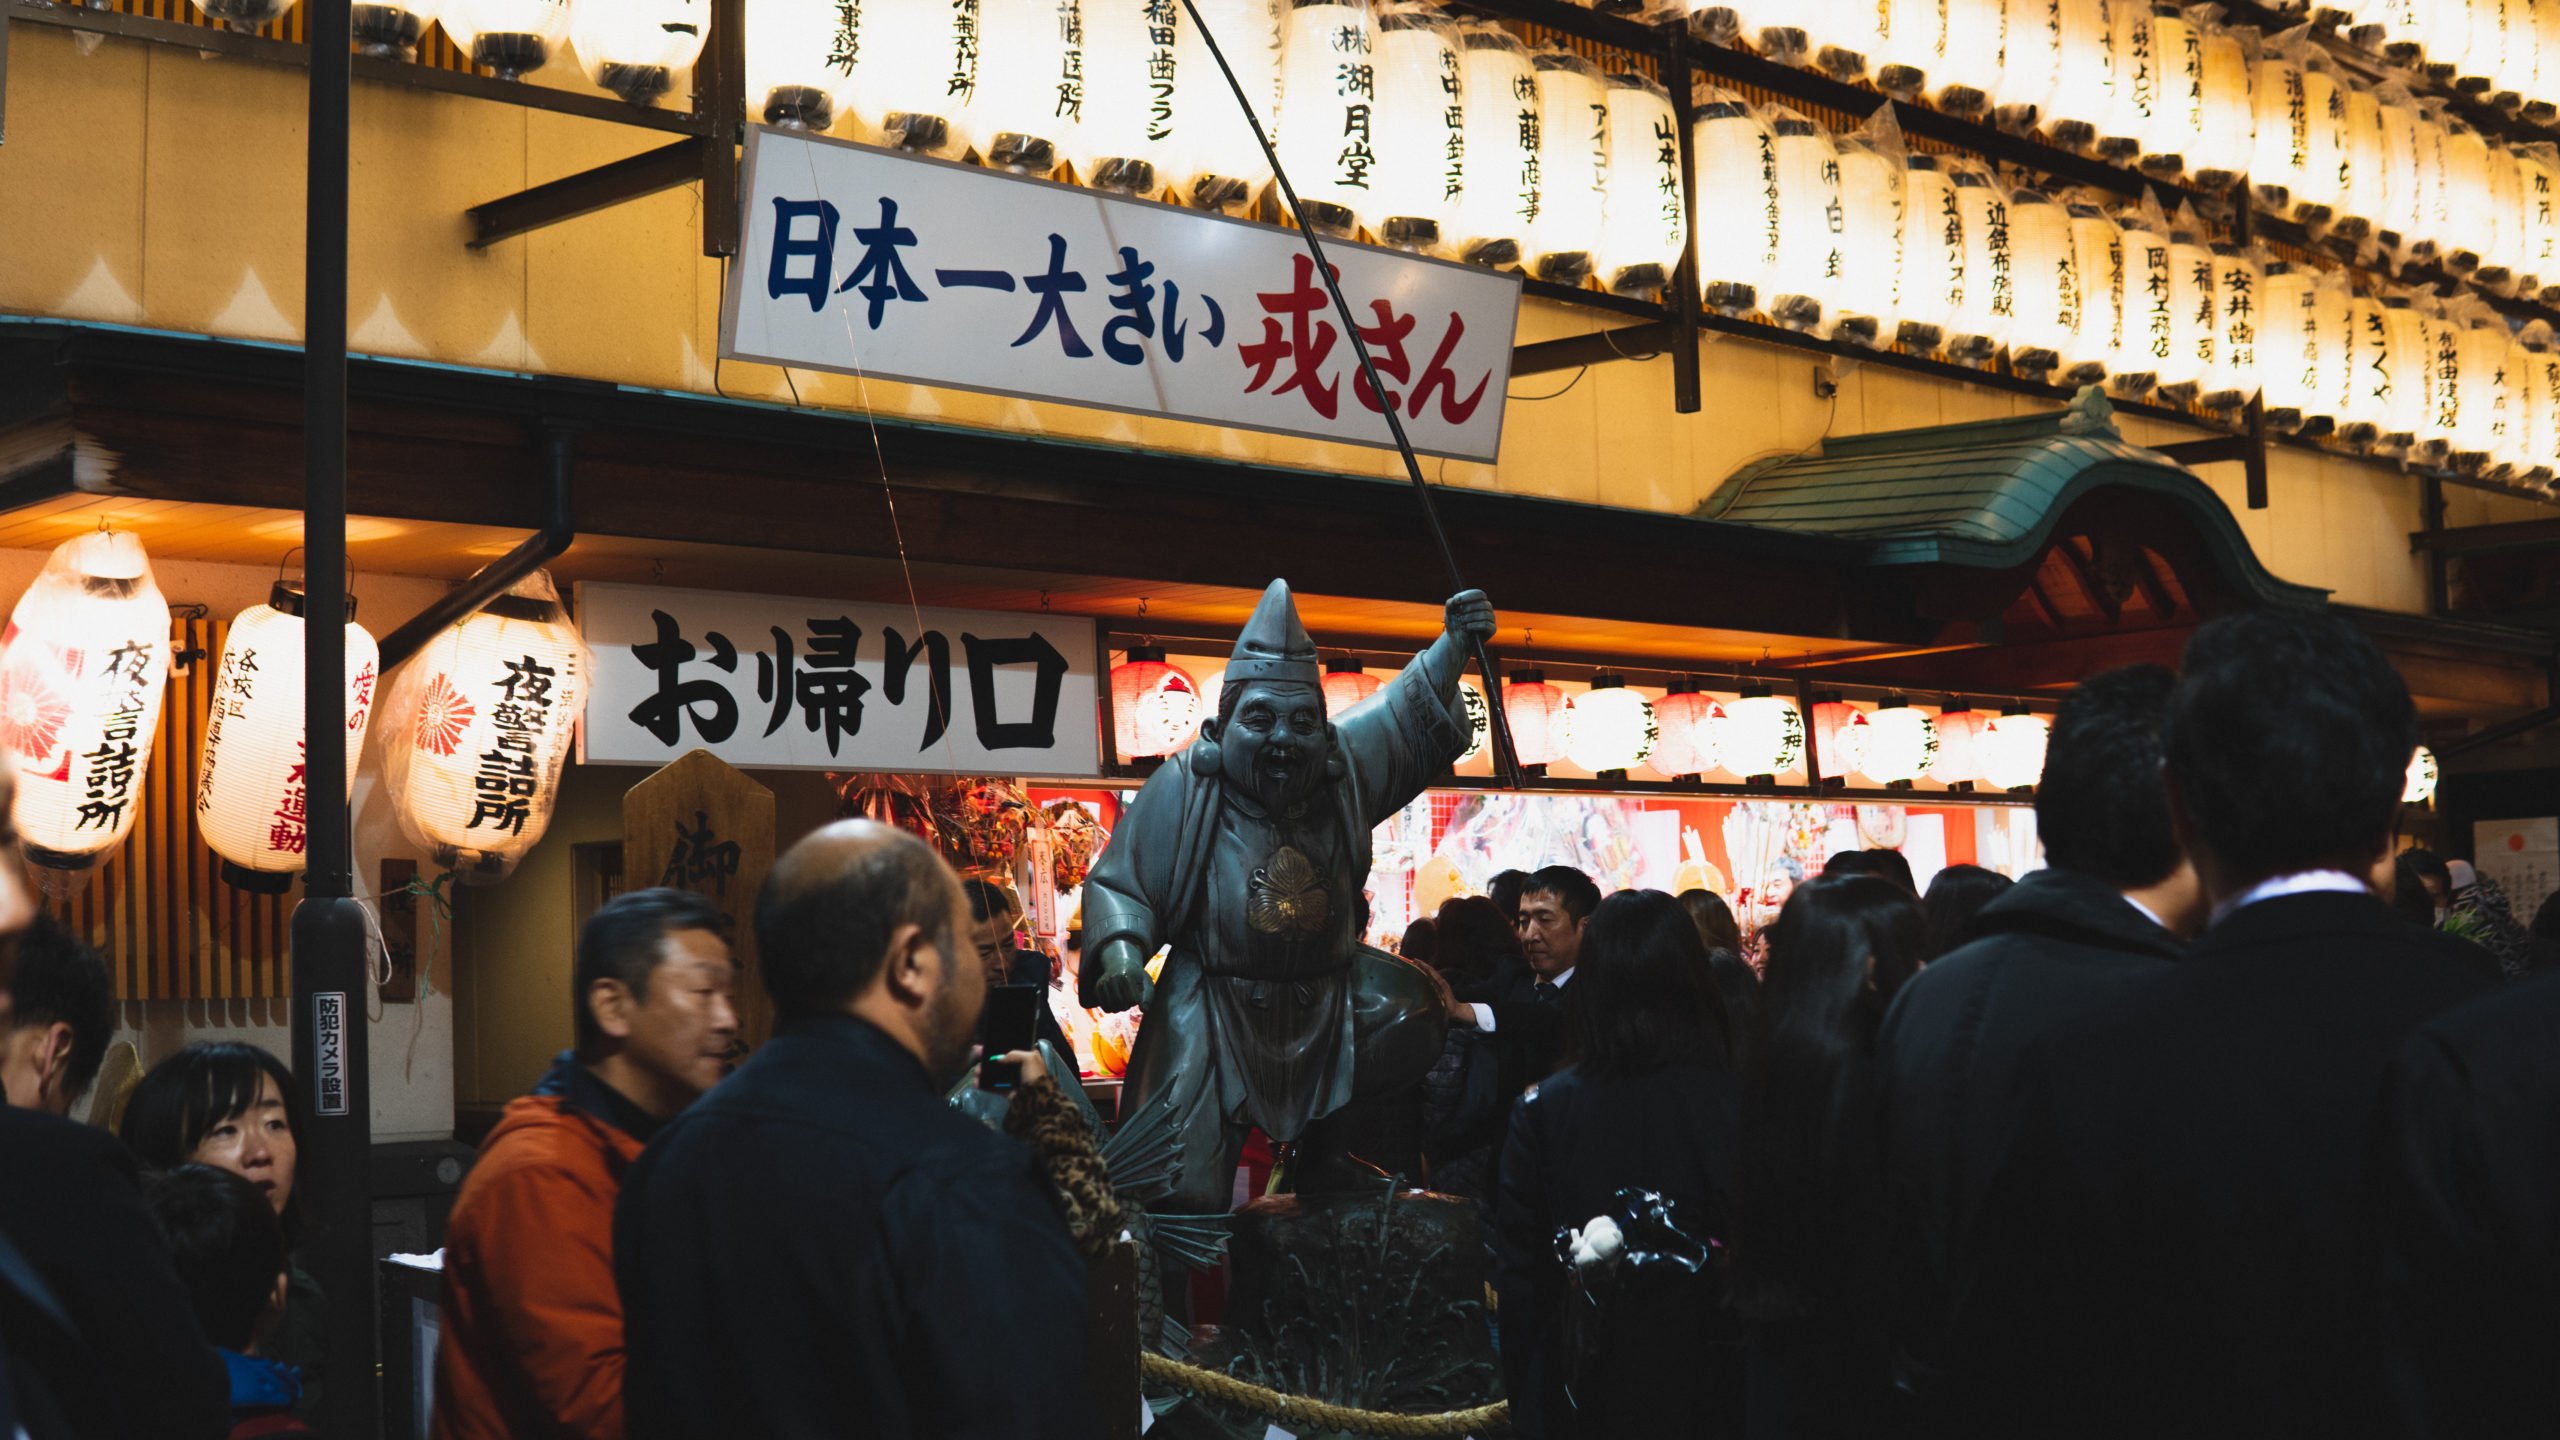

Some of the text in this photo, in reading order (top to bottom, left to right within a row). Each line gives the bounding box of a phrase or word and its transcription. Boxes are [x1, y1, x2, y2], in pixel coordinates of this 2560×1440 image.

[824, 0, 864, 78] 事務所
[1985, 200, 2015, 318] 近鉄布施駅
[2222, 267, 2256, 370] 安井歯科
[627, 608, 1070, 759] お帰り口
[1774, 706, 1803, 769] 戎神社
[465, 654, 556, 838] 夜警詰所
[319, 998, 342, 1110] 防犯カメラ設置
